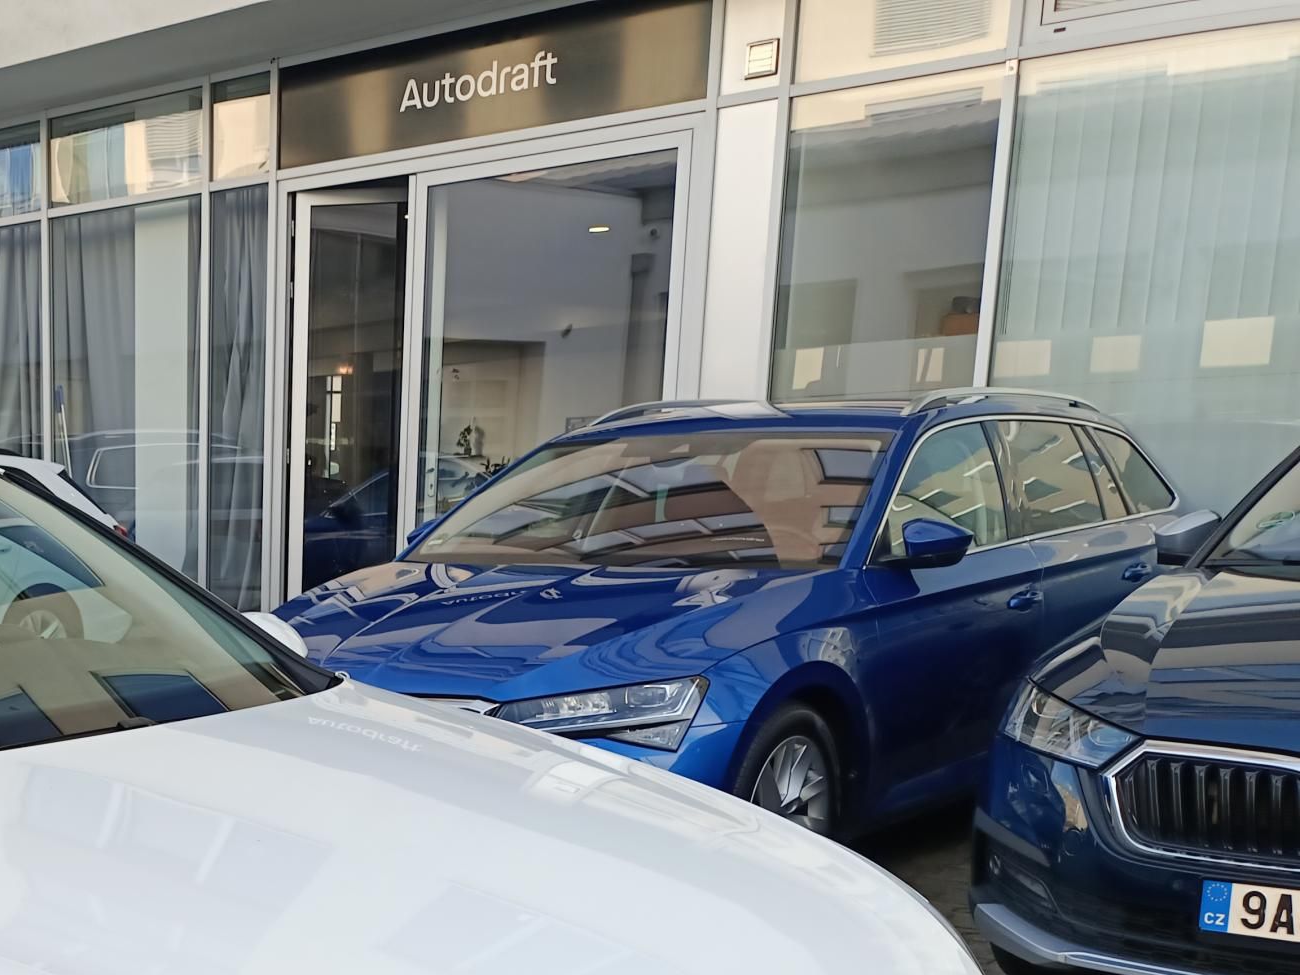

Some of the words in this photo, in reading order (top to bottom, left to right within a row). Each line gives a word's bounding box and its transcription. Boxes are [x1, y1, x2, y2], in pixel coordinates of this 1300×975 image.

[399, 50, 558, 113] Autodraft
[1203, 911, 1226, 926] CZ
[1240, 890, 1295, 936] 9A
